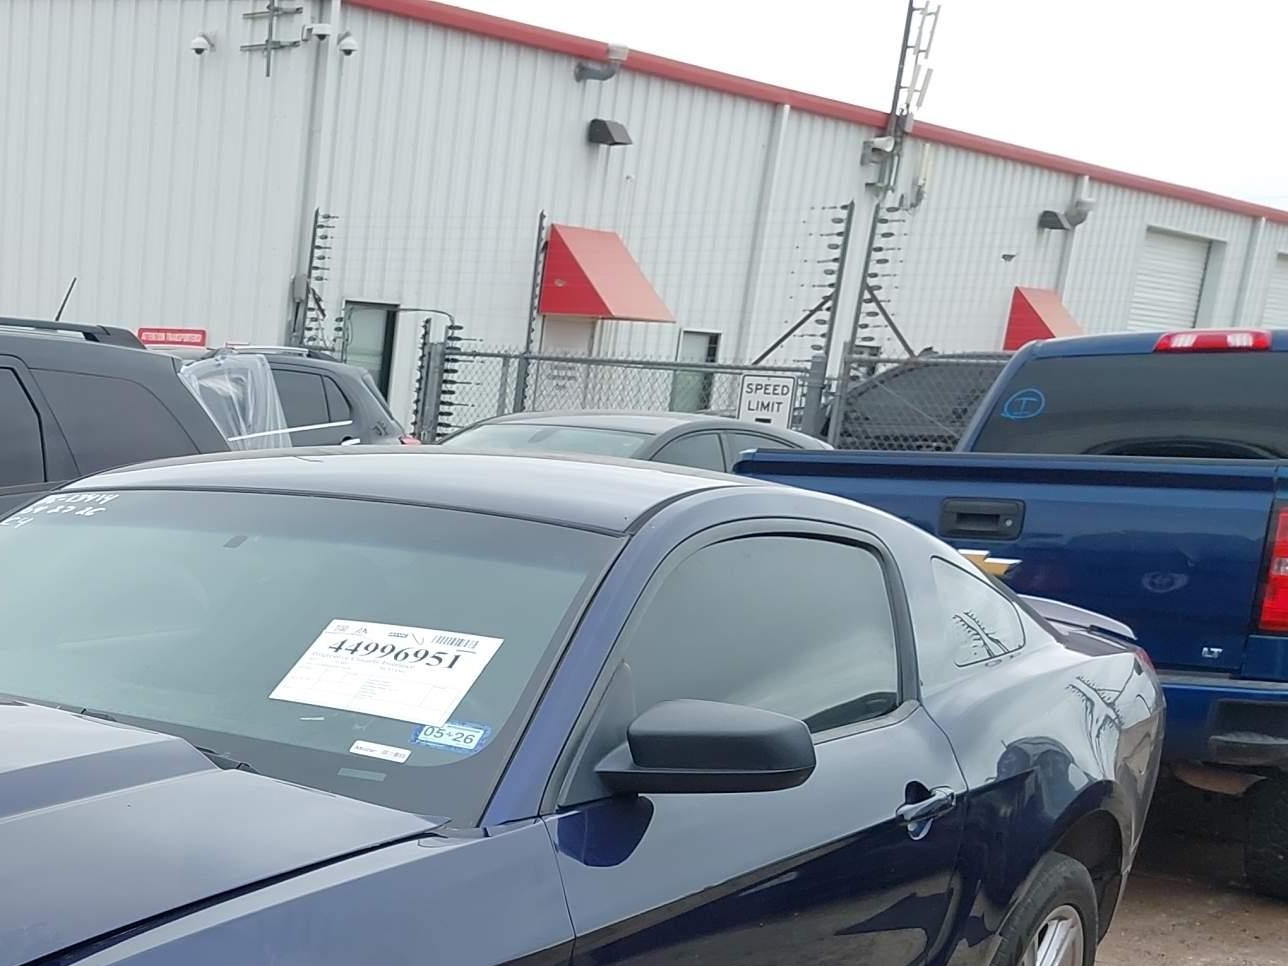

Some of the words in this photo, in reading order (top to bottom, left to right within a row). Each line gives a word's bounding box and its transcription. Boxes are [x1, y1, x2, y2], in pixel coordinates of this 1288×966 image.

[745, 383, 790, 396] SPEED
[747, 400, 783, 413] LIMIT
[328, 638, 462, 669] 44996951
[1202, 647, 1223, 658] LT
[423, 725, 446, 738] 05
[452, 732, 475, 744] 26
